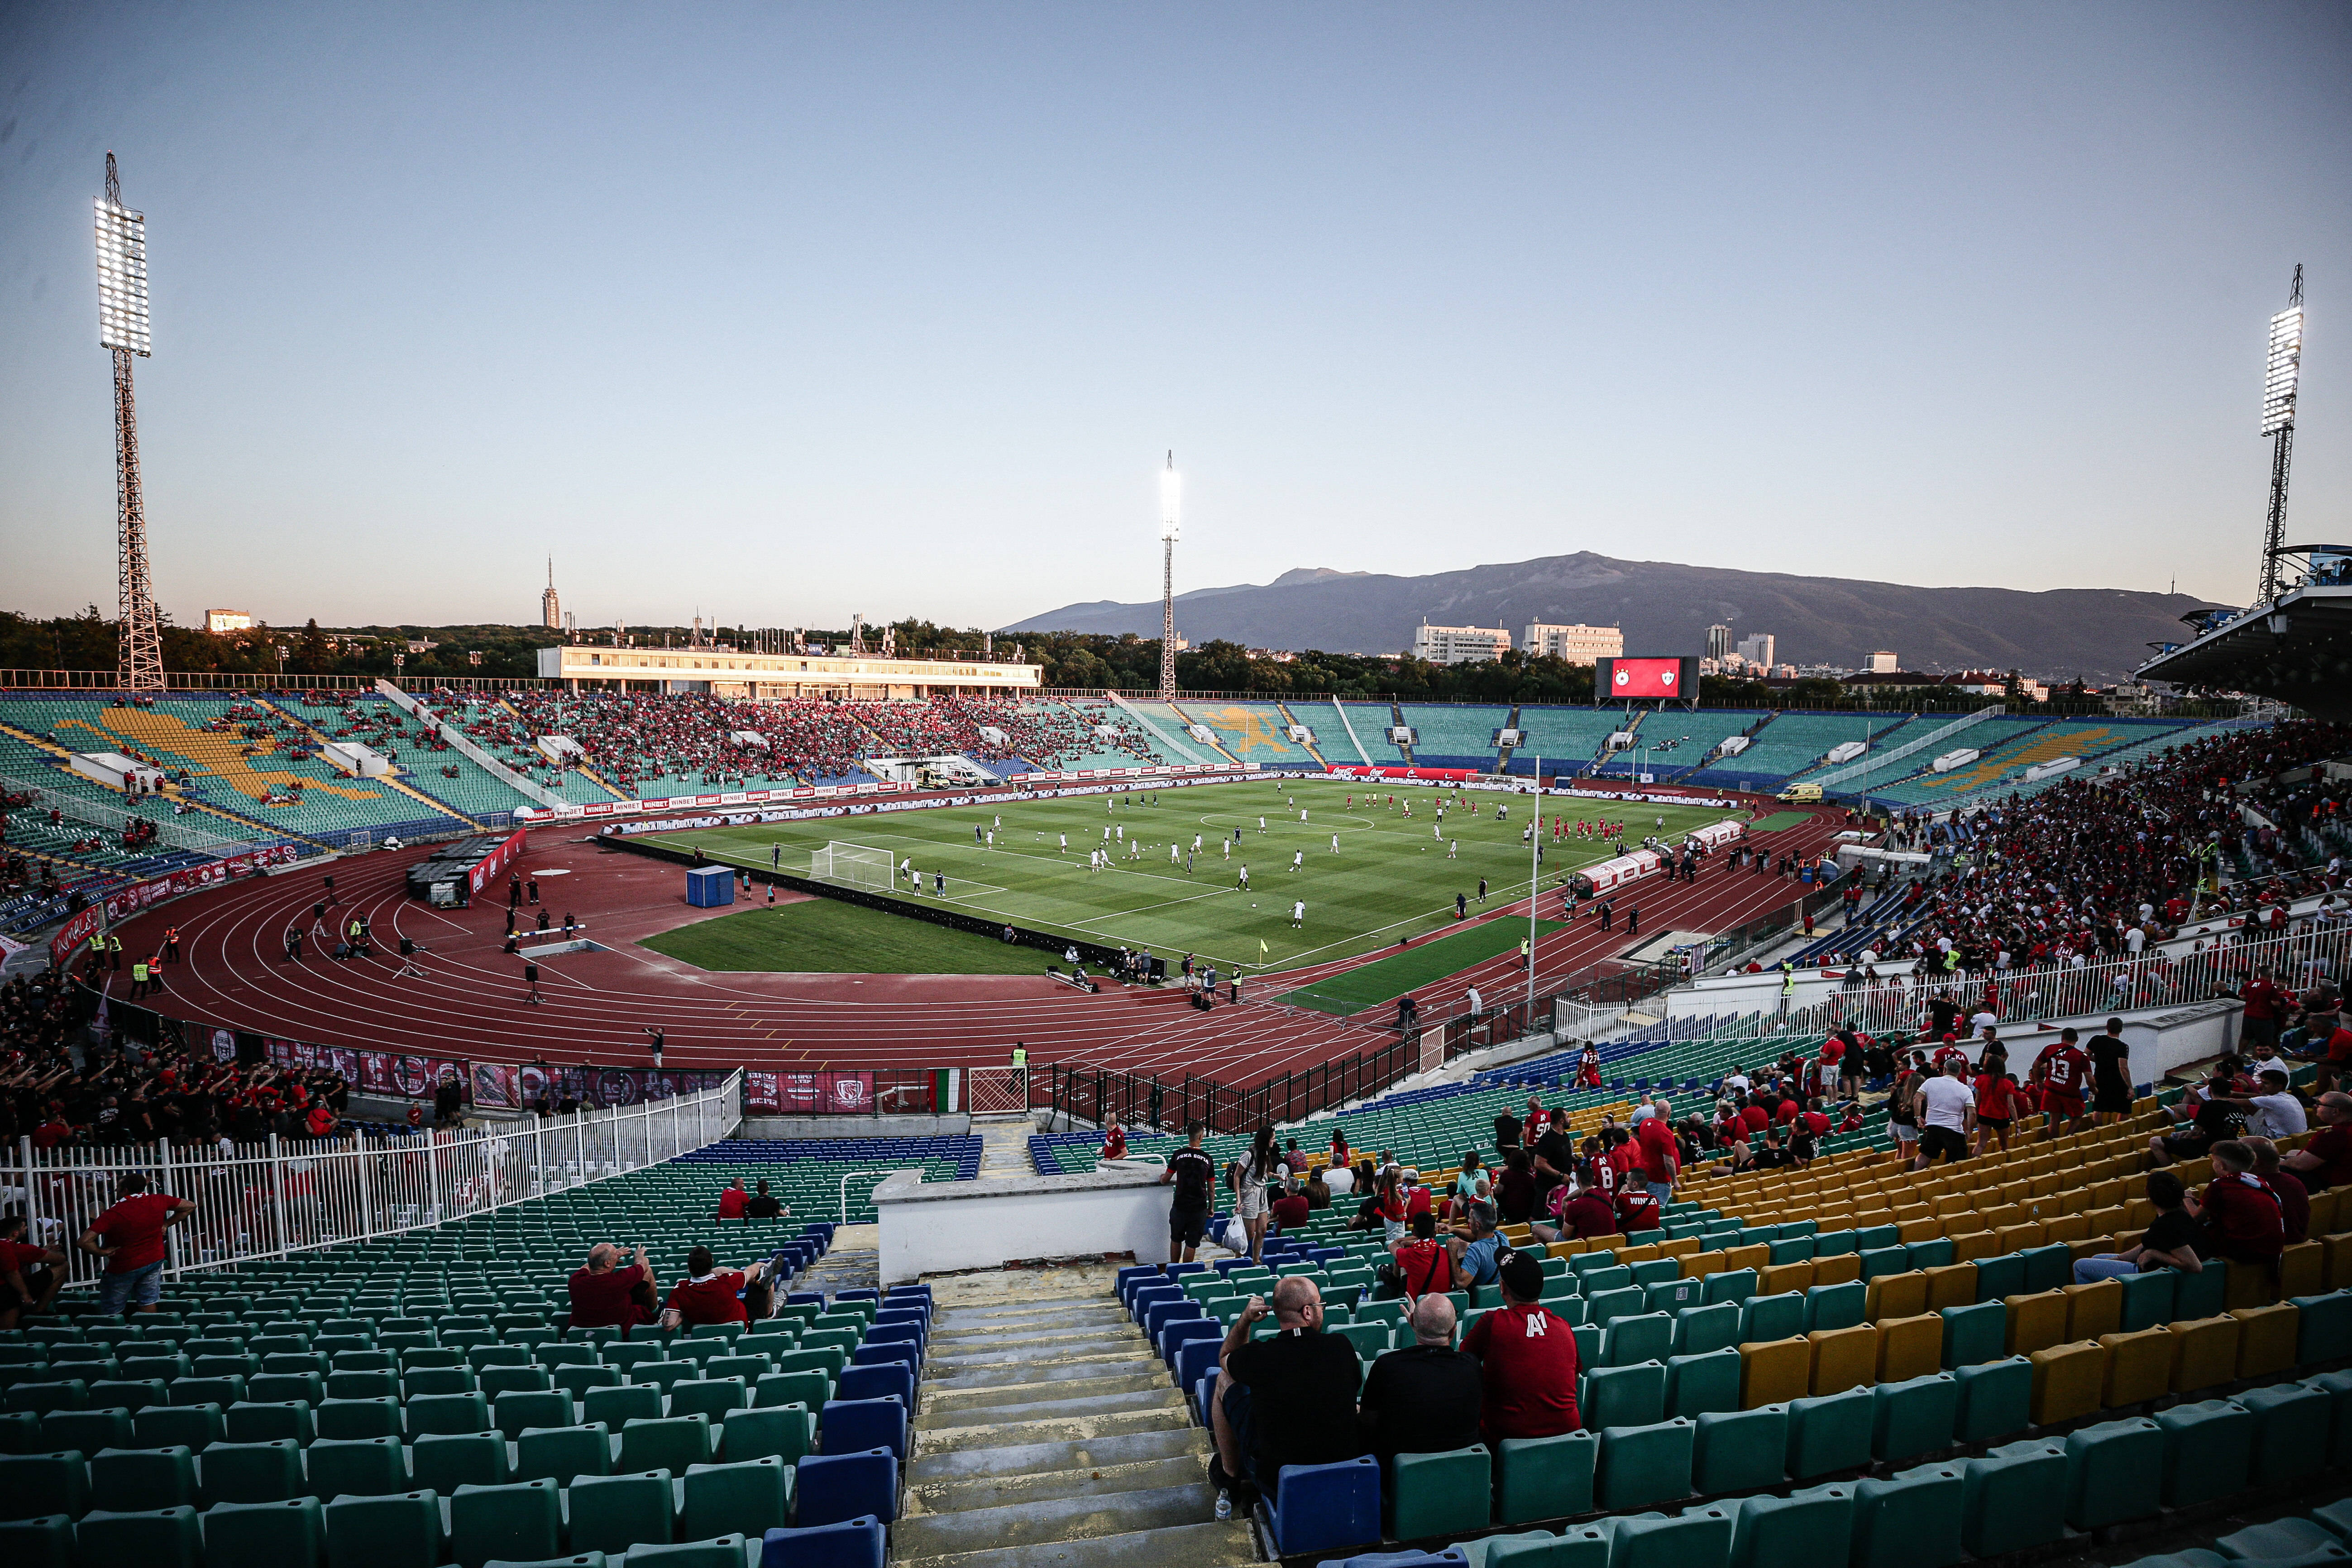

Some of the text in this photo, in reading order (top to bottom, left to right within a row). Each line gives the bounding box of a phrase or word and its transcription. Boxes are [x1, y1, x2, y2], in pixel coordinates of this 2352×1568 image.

[586, 805, 611, 813] WINBET
[1589, 1055, 1597, 1064] 23
[2051, 1057, 2070, 1079] 13
[1599, 1156, 1607, 1166] A1
[1601, 1166, 1613, 1189] 8
[1526, 1310, 1548, 1338] A1
